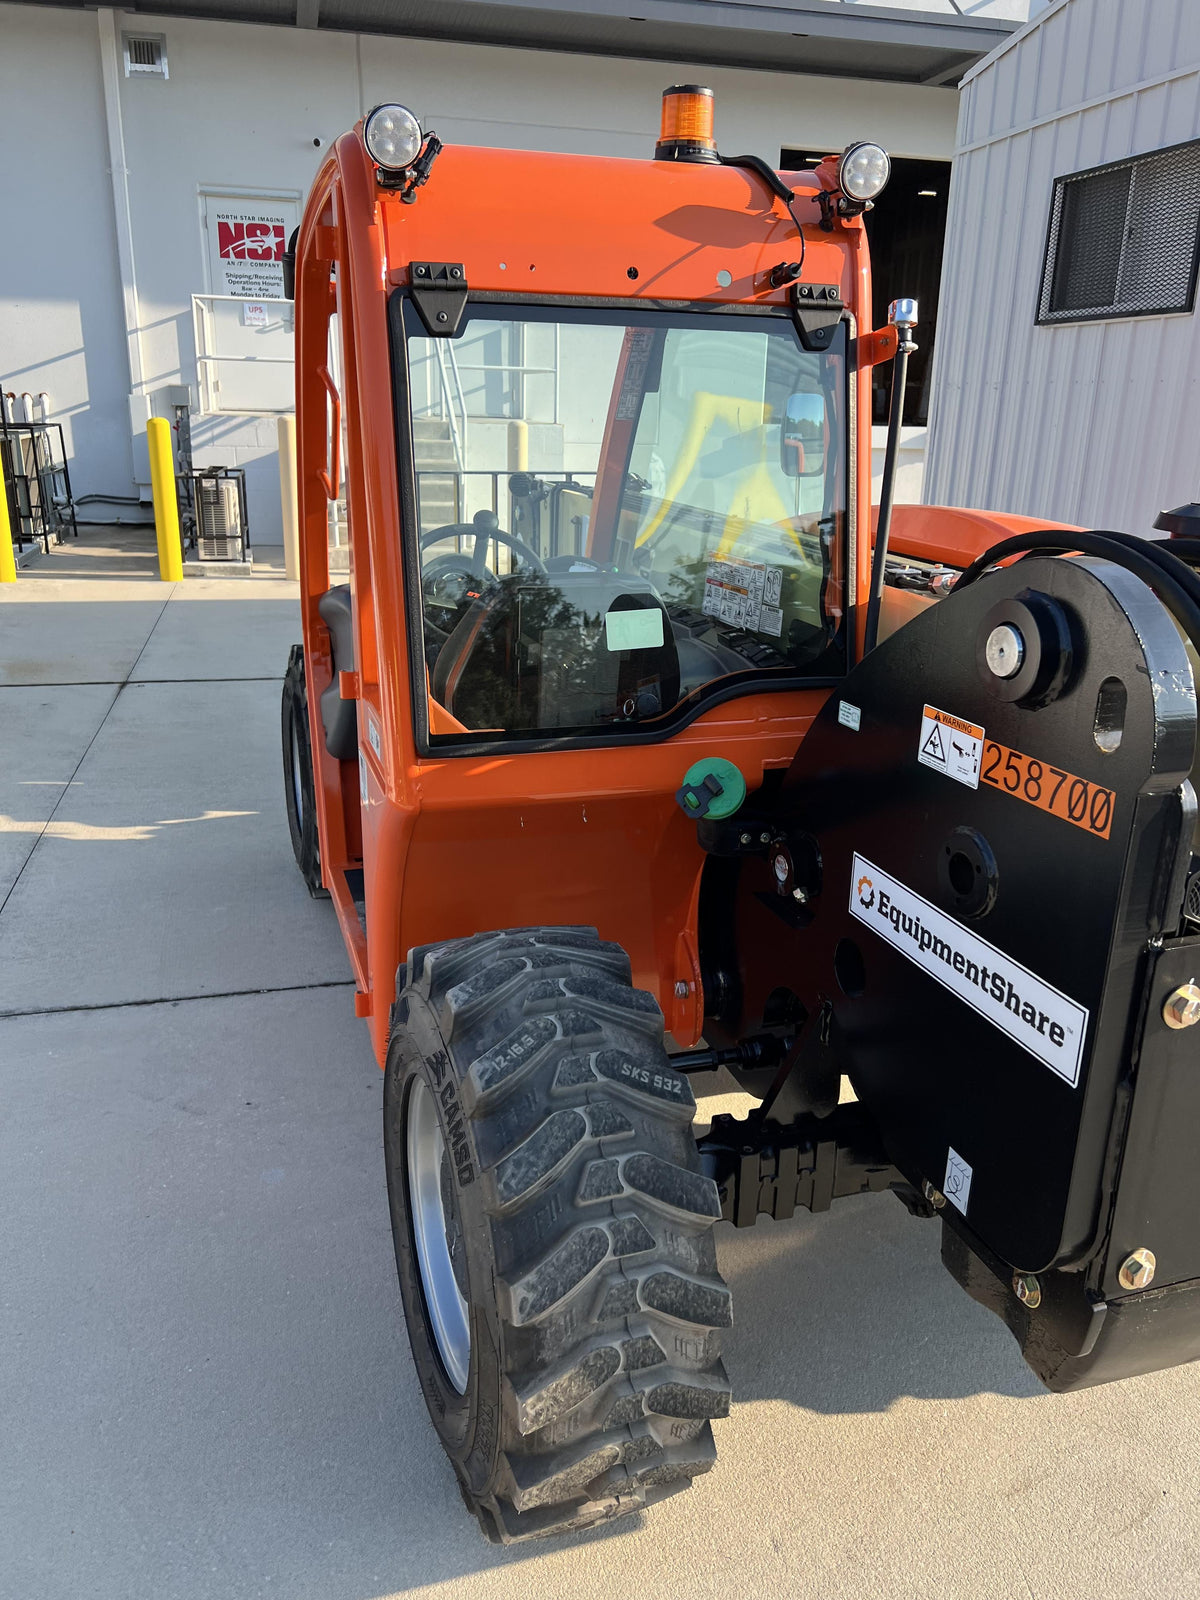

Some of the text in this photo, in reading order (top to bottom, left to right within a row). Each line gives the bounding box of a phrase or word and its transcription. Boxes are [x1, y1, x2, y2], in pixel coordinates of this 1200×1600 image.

[218, 222, 286, 261] NSI
[225, 273, 283, 281] Shipping/Receiving
[942, 715, 973, 733] WARNING
[982, 743, 1112, 833] 258700
[878, 890, 1065, 1048] EquipmentShare
[621, 1063, 682, 1094] SKS 532
[440, 1080, 475, 1188] CAMSO
